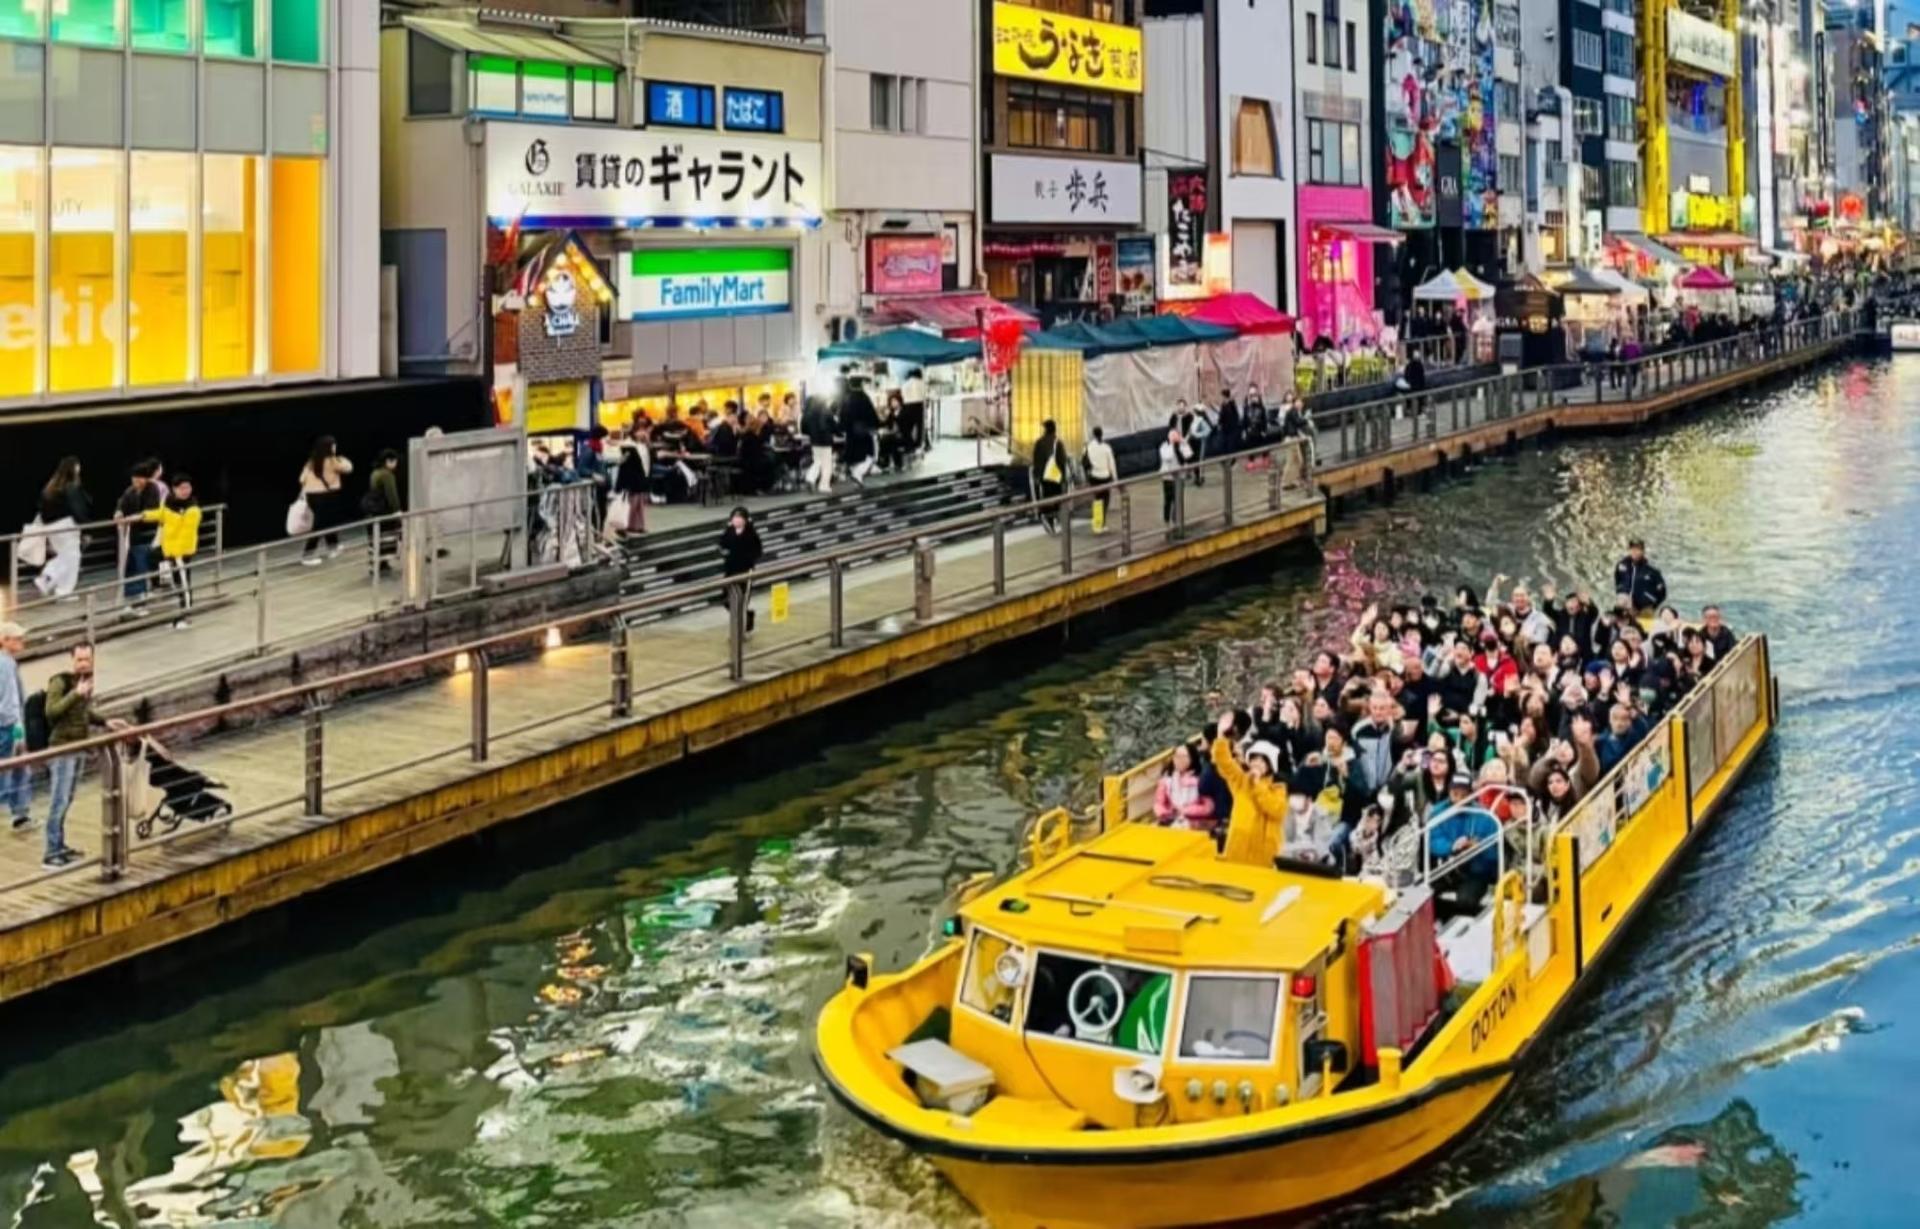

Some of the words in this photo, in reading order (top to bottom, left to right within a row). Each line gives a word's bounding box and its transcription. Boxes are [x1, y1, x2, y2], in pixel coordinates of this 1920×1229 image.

[665, 89, 684, 120] 酒
[726, 96, 766, 125] たばこ
[575, 144, 805, 202] 賃貸のギャラント
[1065, 167, 1109, 213] 歩兵
[660, 276, 764, 307] FamilyMart
[1470, 982, 1517, 1054] DOTON
